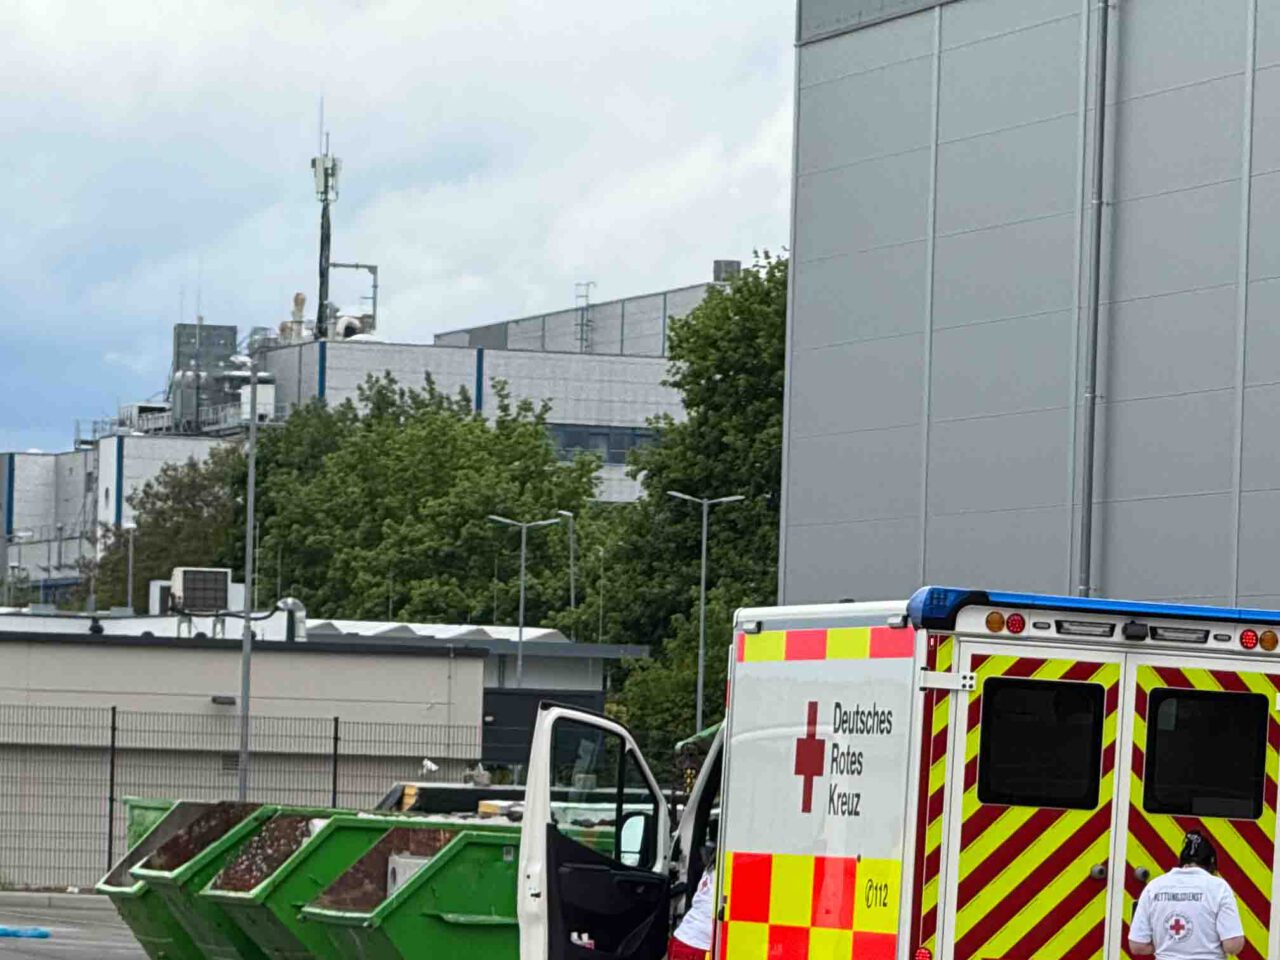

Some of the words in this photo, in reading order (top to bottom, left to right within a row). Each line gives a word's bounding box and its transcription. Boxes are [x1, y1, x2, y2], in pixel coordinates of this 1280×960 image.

[833, 701, 893, 735] Deutsches
[830, 742, 863, 776] Rotes
[828, 783, 861, 816] Kreuz
[874, 882, 889, 908] 112
